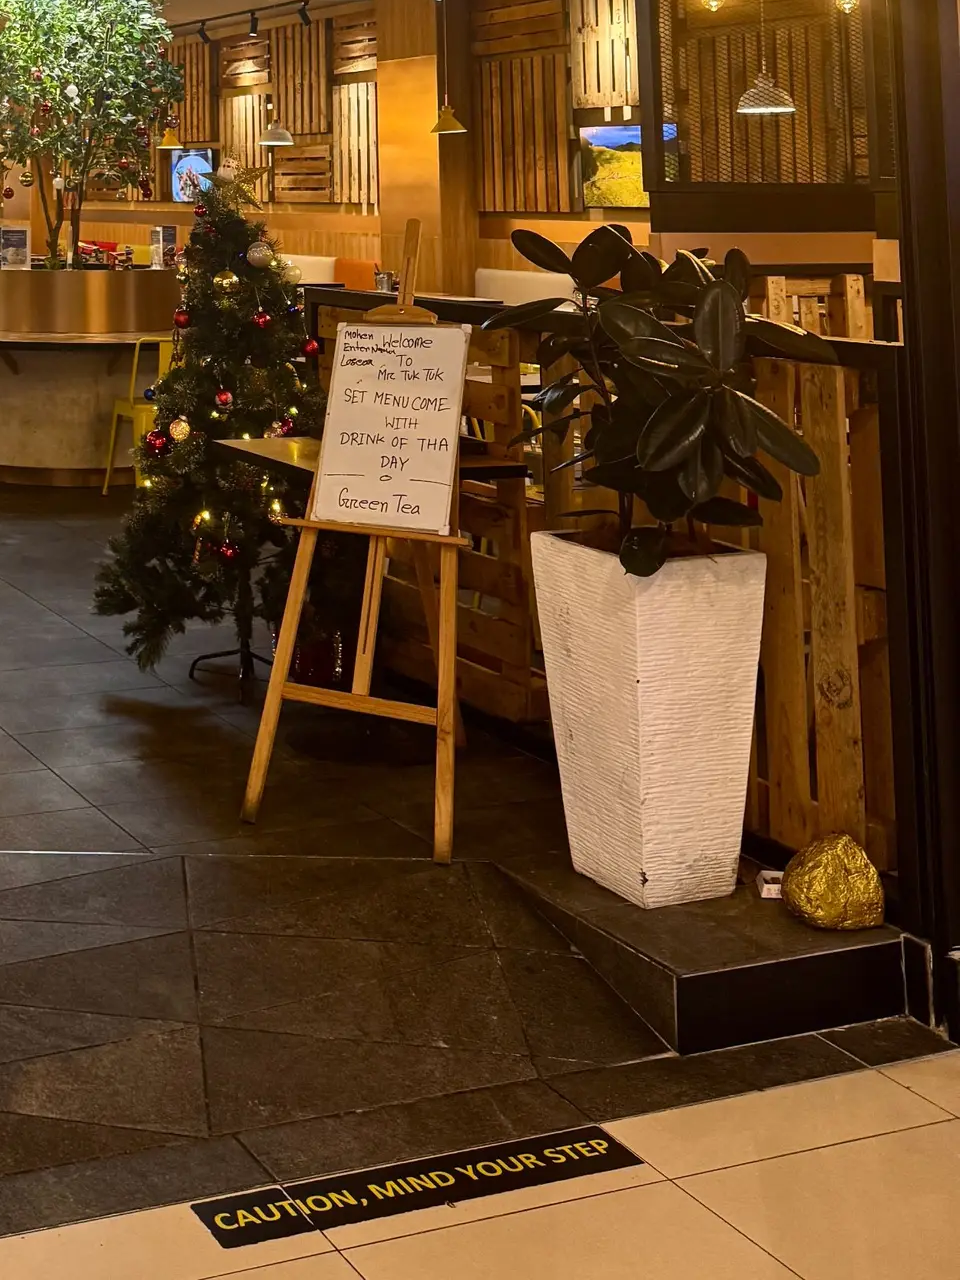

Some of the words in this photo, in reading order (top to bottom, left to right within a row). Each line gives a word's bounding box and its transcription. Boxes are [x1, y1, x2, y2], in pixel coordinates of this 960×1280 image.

[382, 332, 434, 349] Welcome
[344, 388, 368, 404] SET
[373, 391, 410, 409] MENU
[411, 396, 451, 412] COME
[384, 416, 419, 430] WITH
[391, 436, 409, 450] OF
[417, 437, 449, 452] THA
[380, 455, 410, 472] DAY
[392, 493, 421, 515] Tea
[214, 1189, 368, 1231] CAUTION,
[369, 1170, 456, 1199] MIND
[453, 1152, 542, 1182] YOUR
[539, 1138, 610, 1164] STEP
